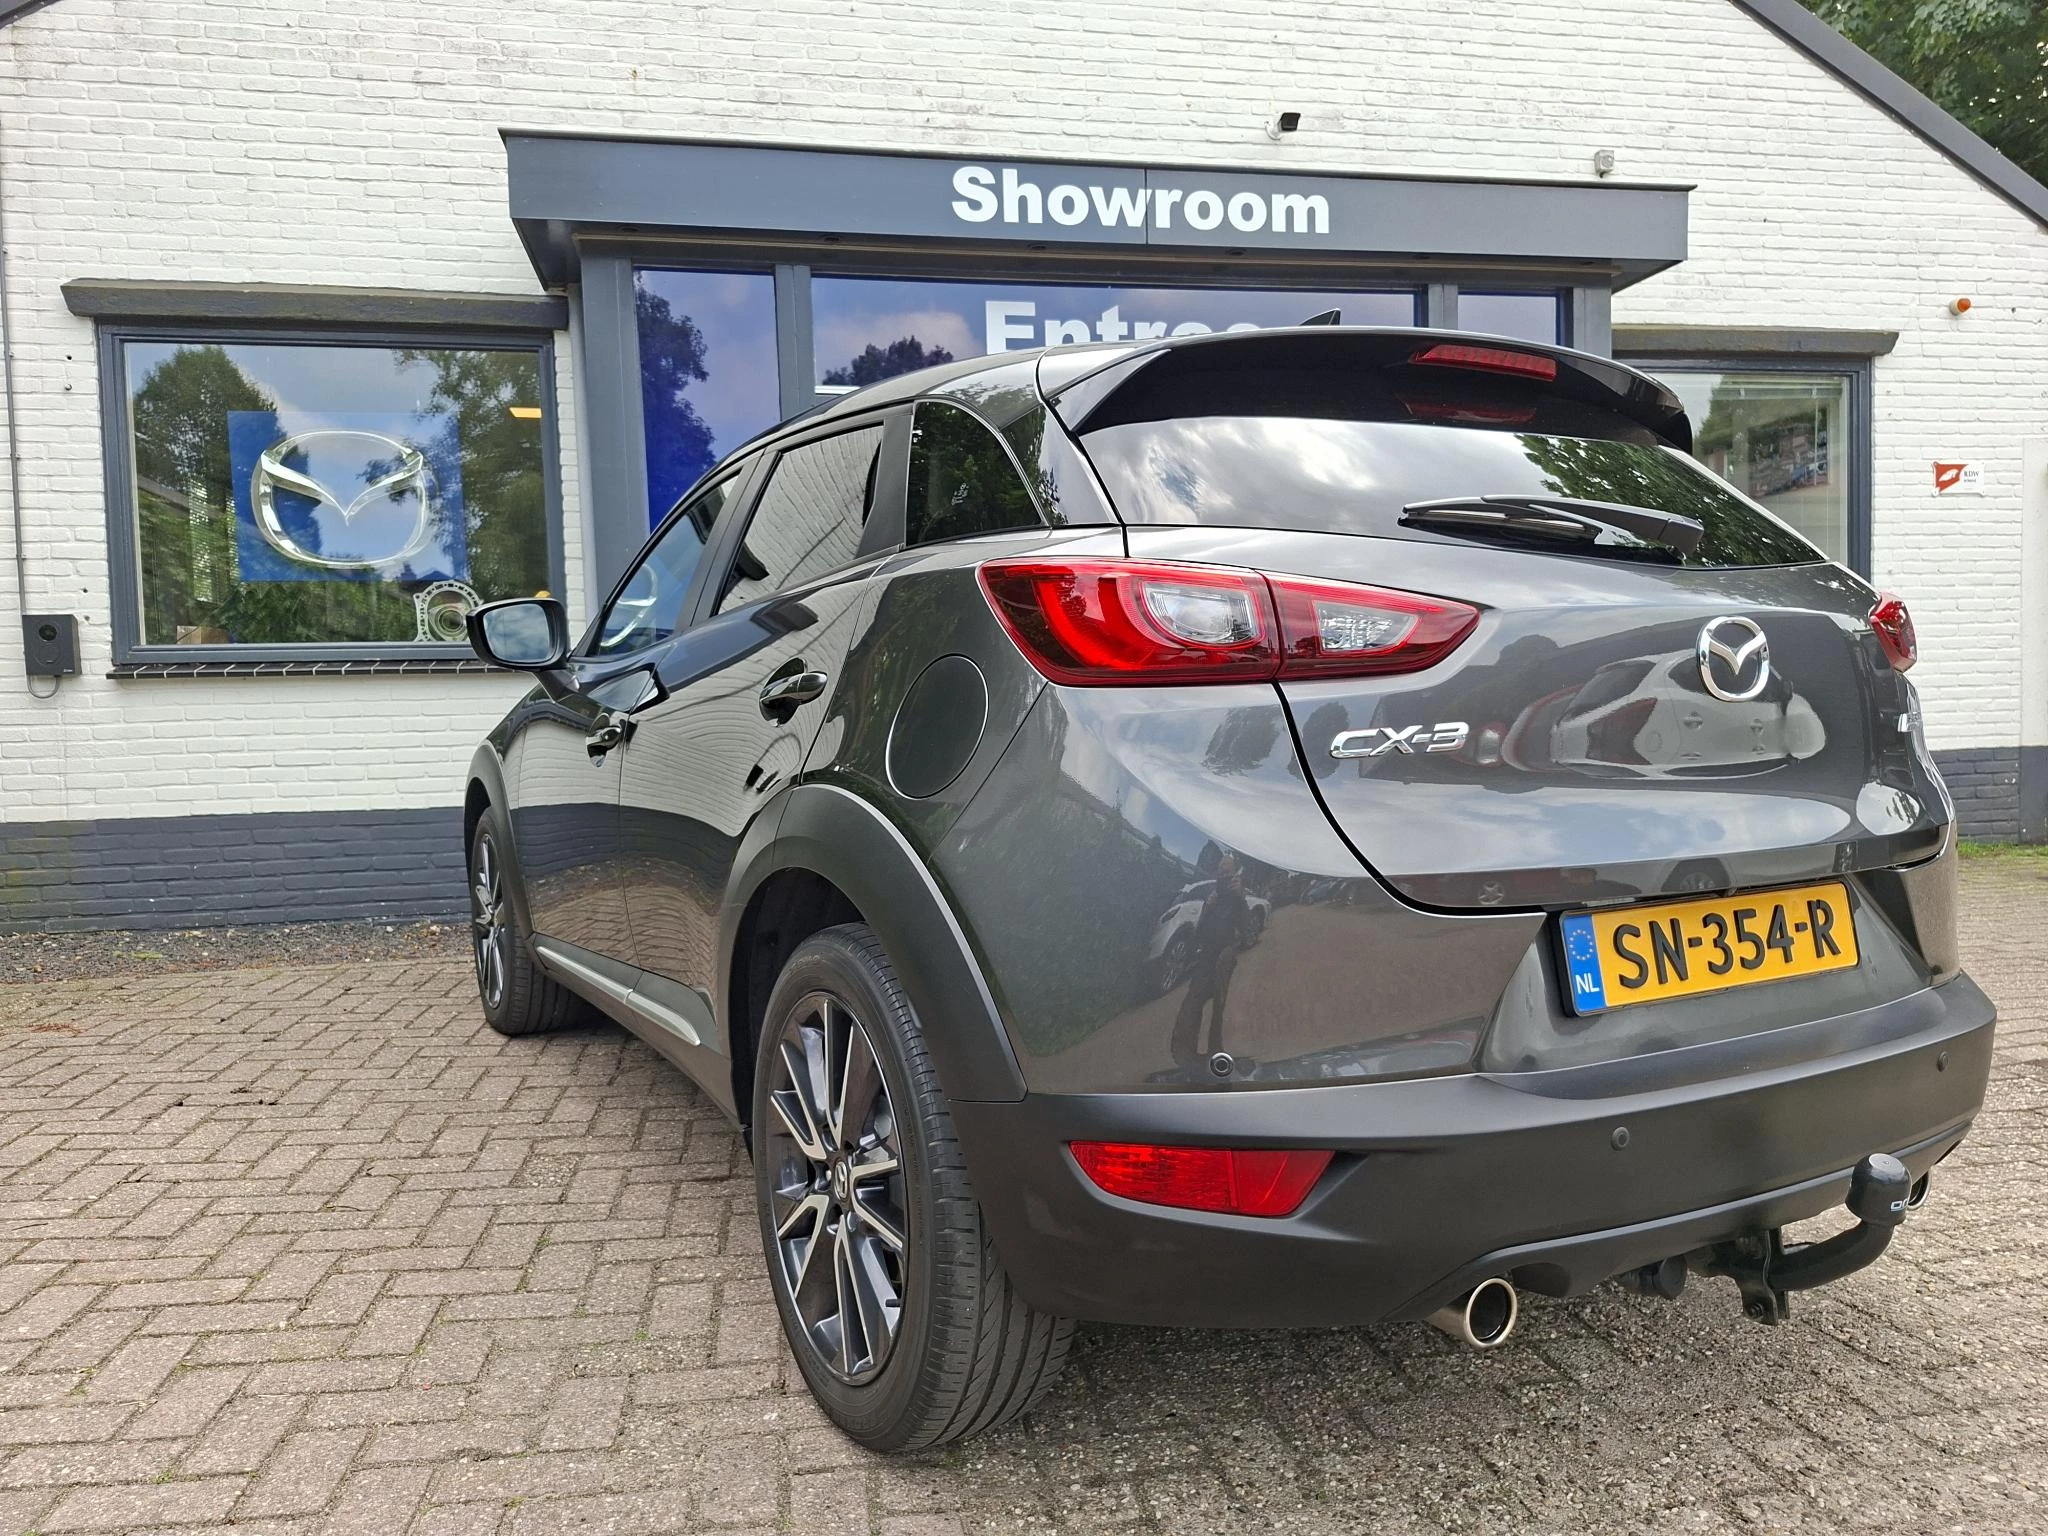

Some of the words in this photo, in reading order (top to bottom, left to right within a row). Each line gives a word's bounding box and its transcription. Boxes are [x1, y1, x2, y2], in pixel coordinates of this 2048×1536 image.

[952, 166, 1330, 234] Showroom
[985, 300, 1260, 355] Ent
[1330, 721, 1470, 759] CX-3
[1612, 898, 1842, 989] SN-354-R
[1575, 971, 1600, 995] NL
